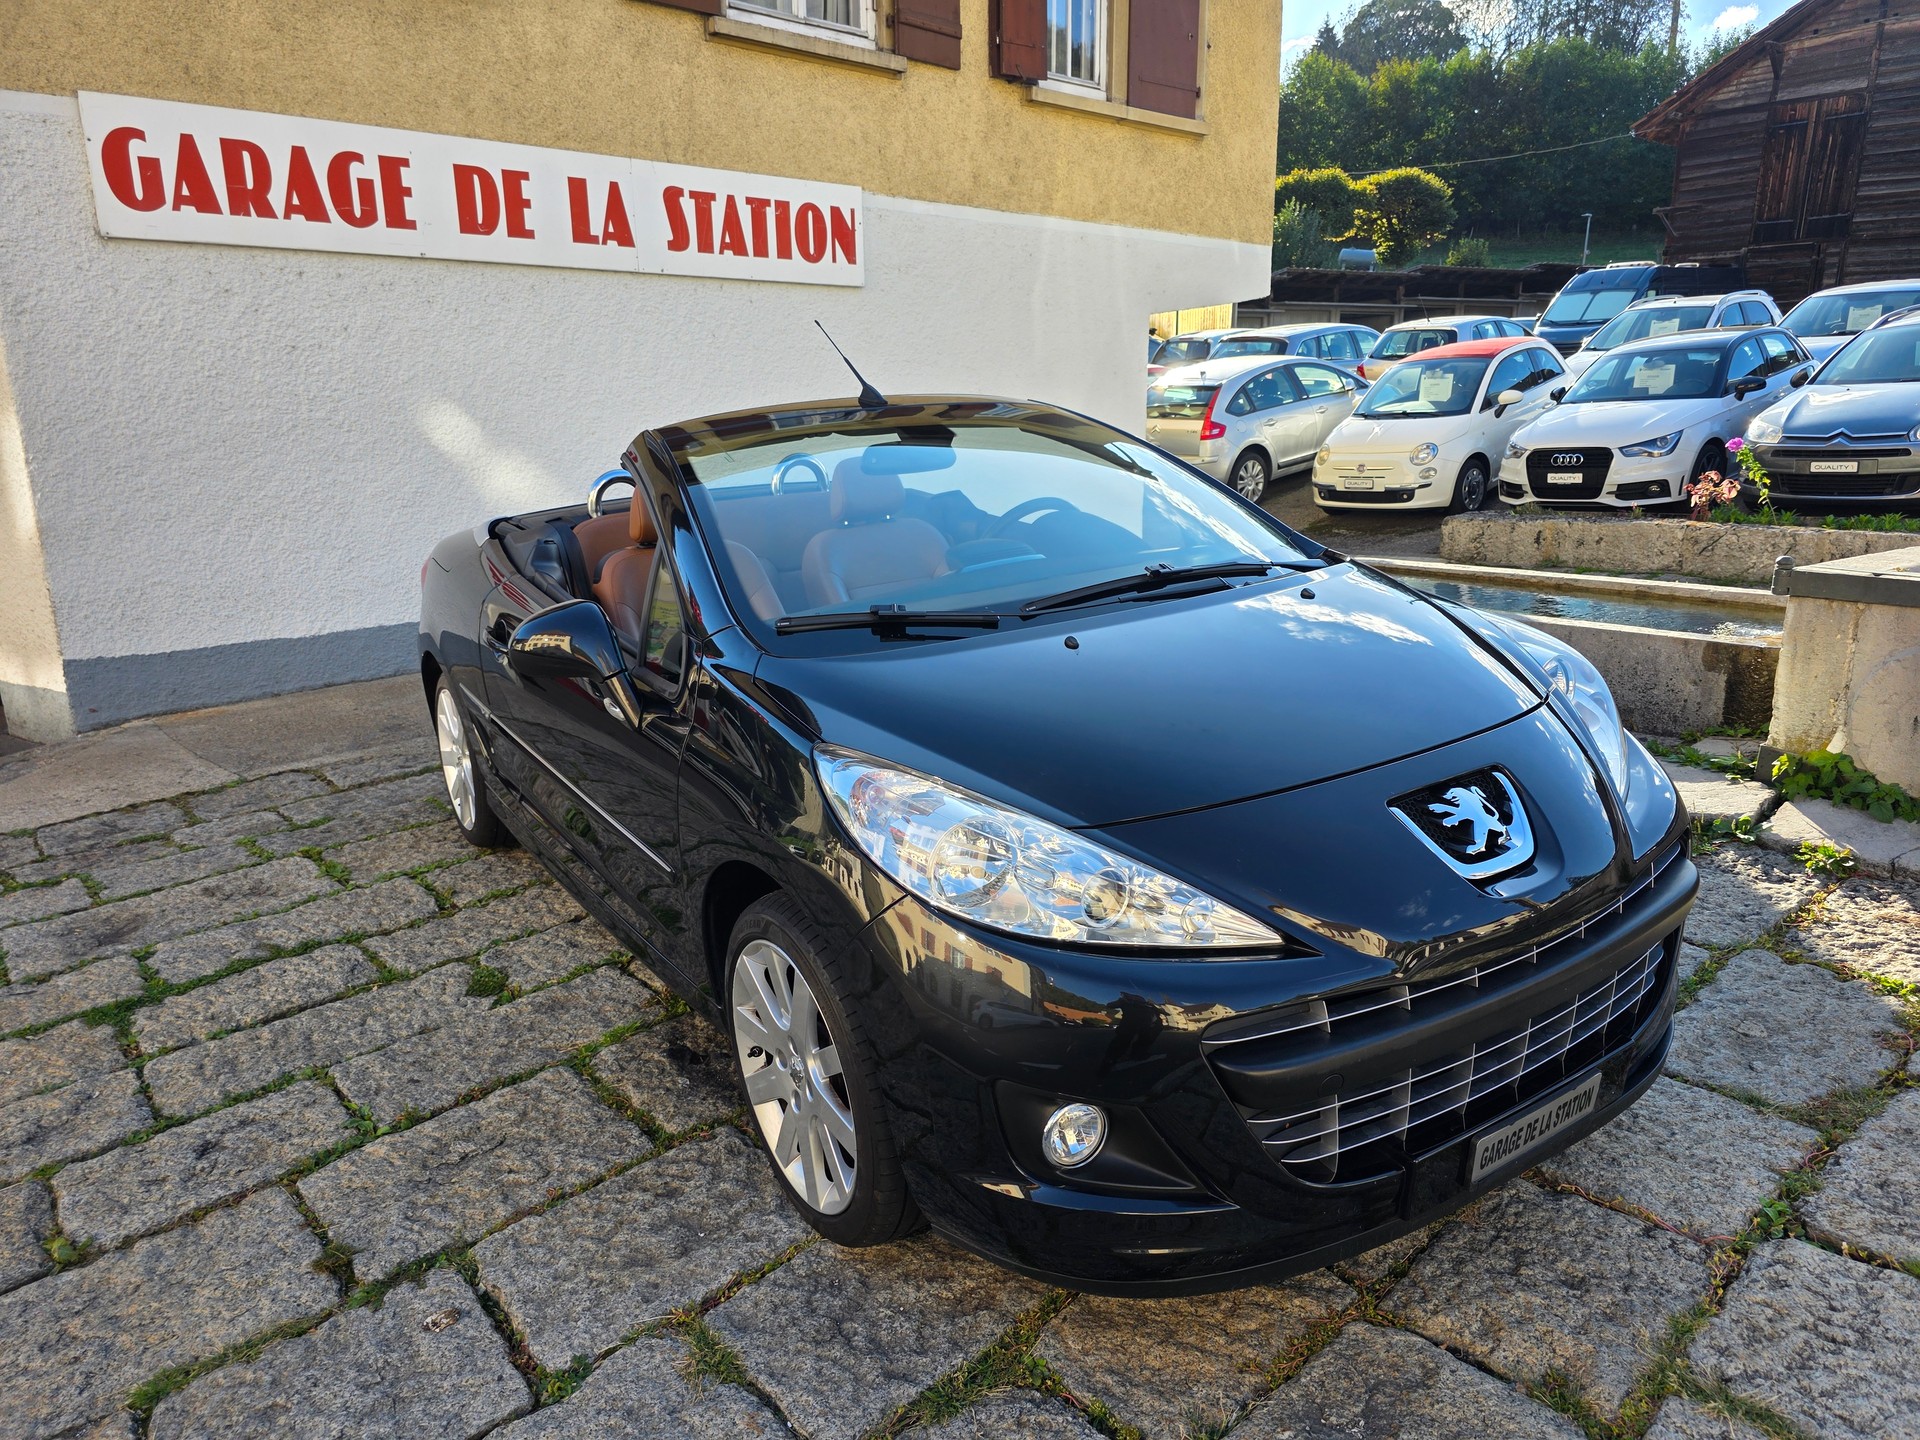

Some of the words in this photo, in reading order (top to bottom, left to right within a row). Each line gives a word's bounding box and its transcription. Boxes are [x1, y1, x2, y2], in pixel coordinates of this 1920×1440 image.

[101, 127, 417, 230] GARAGE
[453, 164, 535, 239] DE
[567, 176, 636, 248] LA
[662, 186, 857, 265] STATION
[1480, 1126, 1525, 1170] GARAGE
[1523, 1117, 1540, 1146] DE
[1538, 1110, 1552, 1135] LA
[1553, 1085, 1595, 1128] STATION
